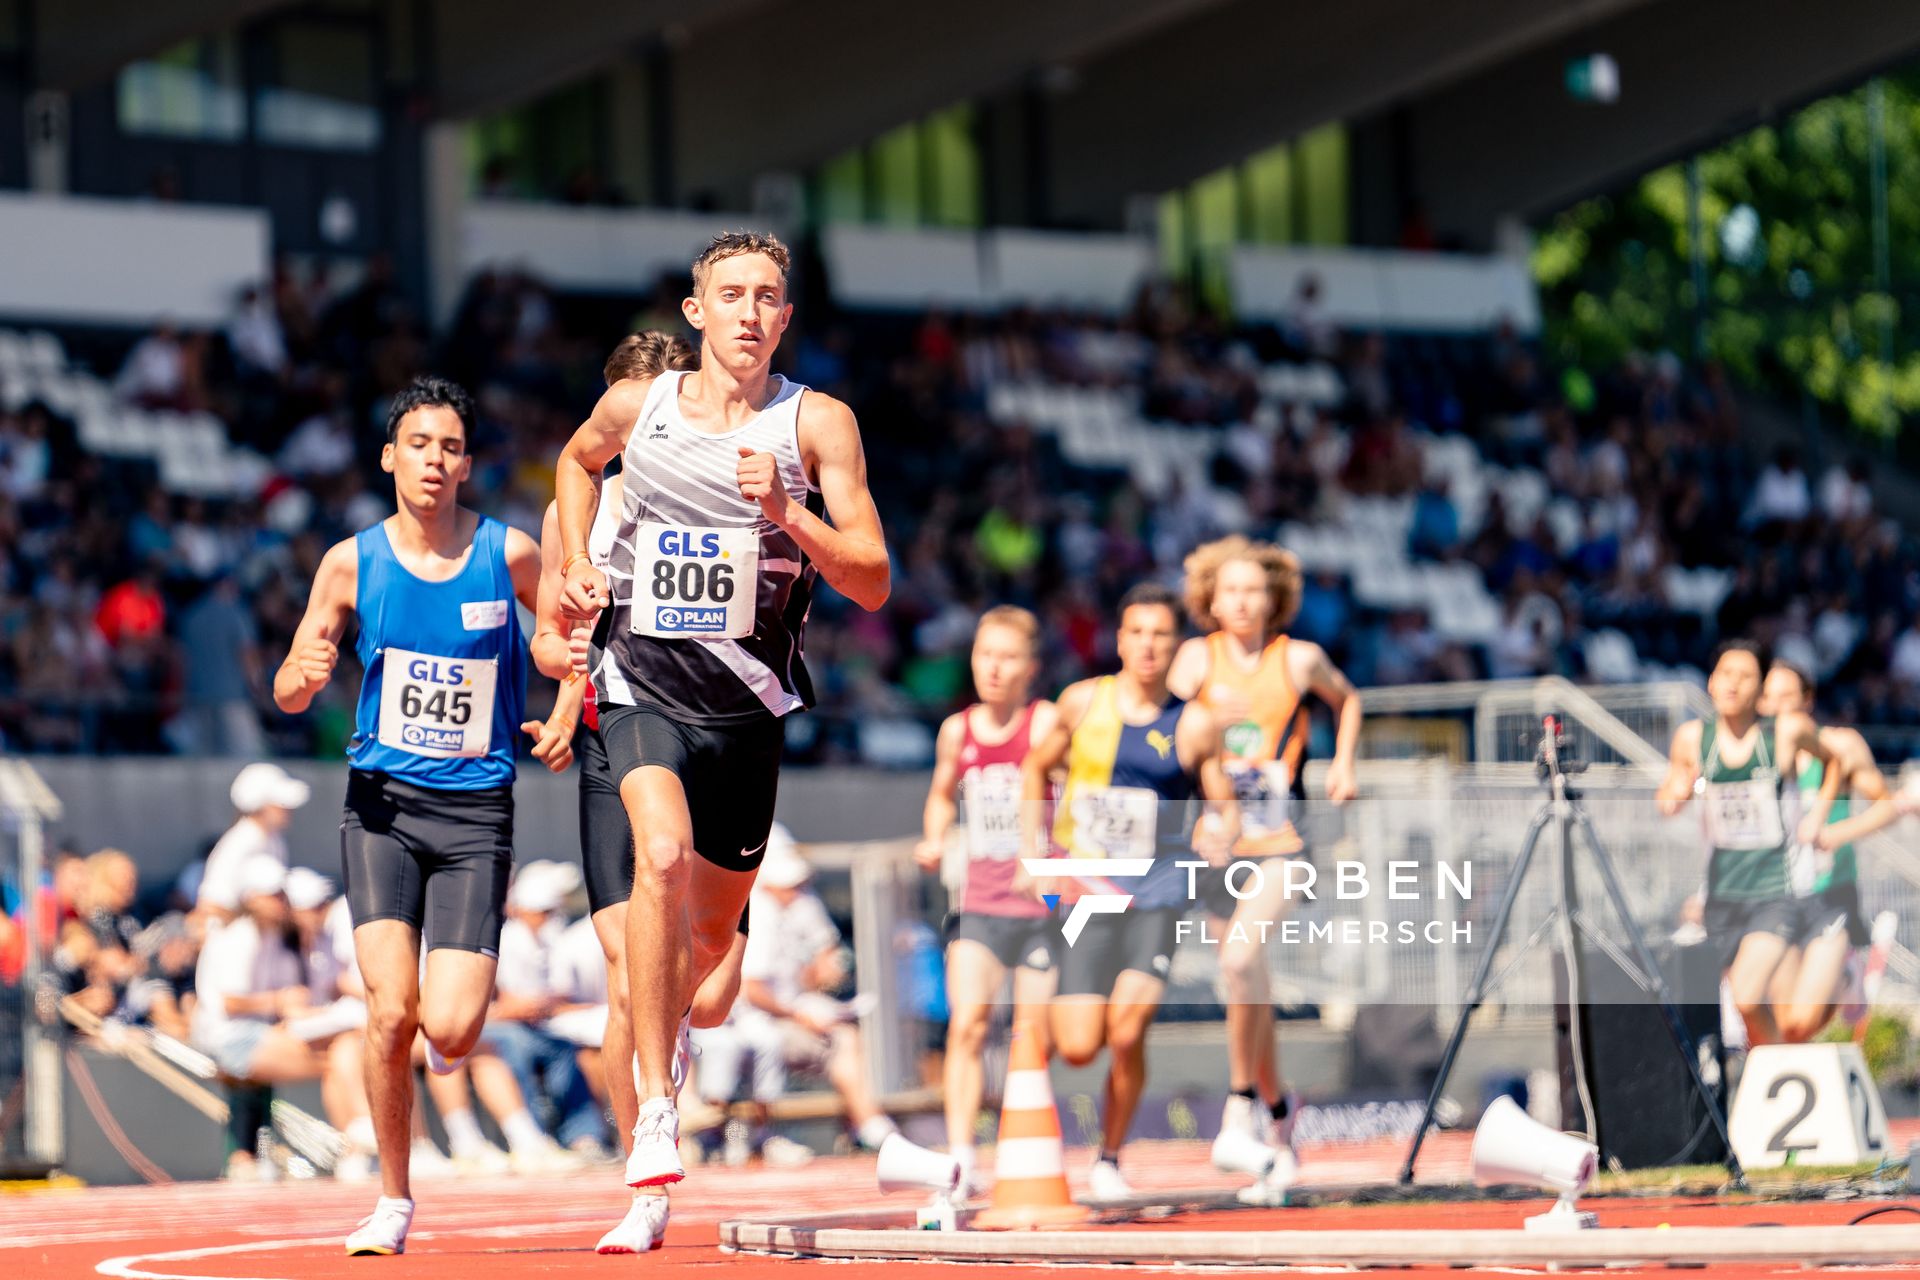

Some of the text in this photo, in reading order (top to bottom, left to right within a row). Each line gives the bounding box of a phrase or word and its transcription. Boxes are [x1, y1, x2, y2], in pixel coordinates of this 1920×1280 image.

[652, 560, 735, 603] 806
[684, 612, 724, 624] PLAN
[400, 684, 473, 725] 645
[426, 731, 462, 744] PLAN
[1767, 1074, 1818, 1152] 2
